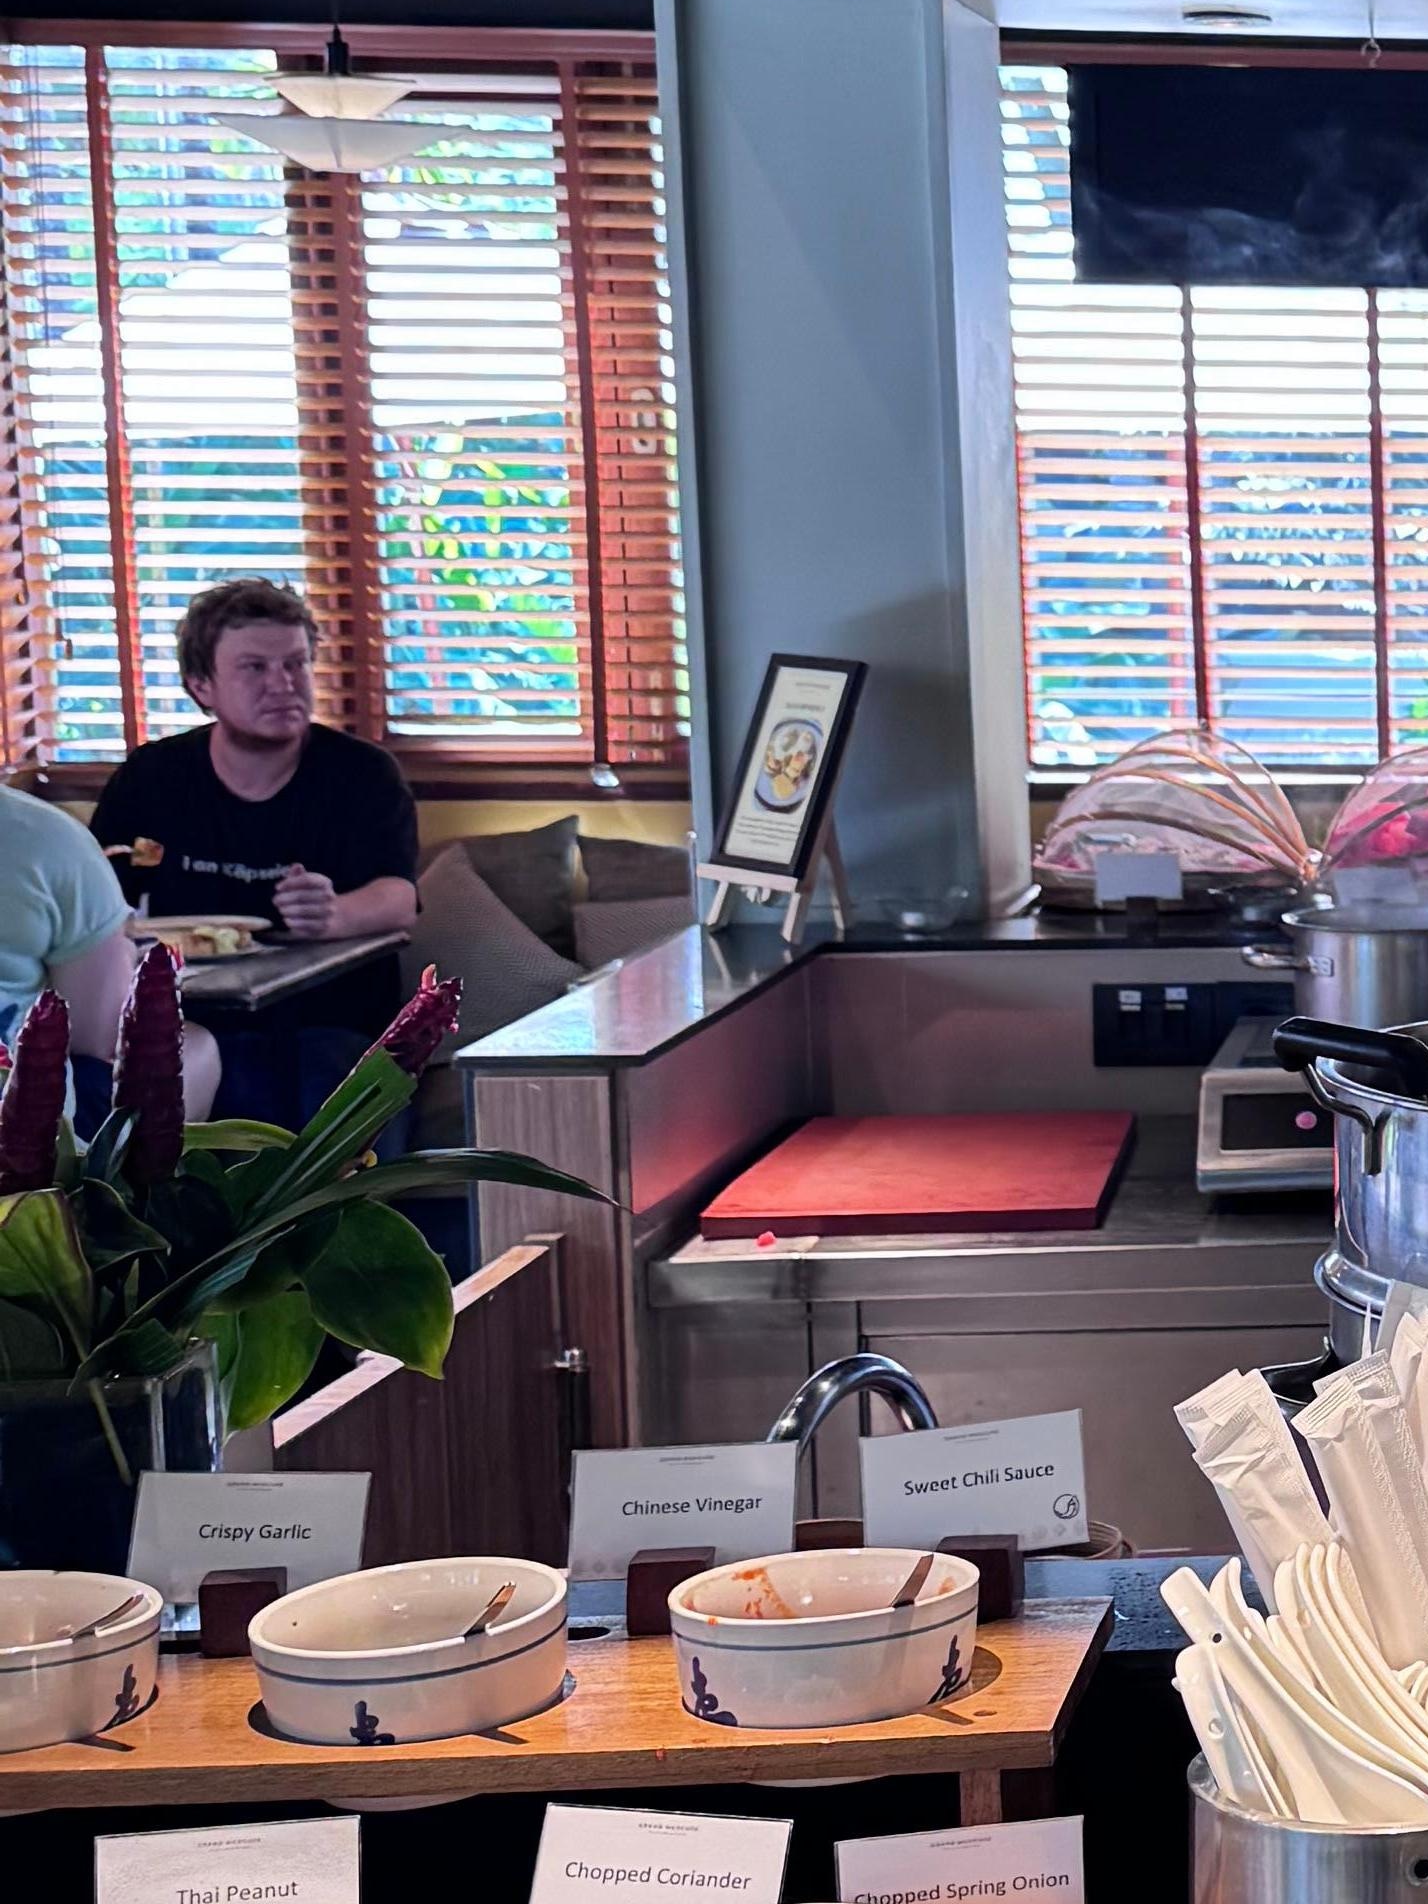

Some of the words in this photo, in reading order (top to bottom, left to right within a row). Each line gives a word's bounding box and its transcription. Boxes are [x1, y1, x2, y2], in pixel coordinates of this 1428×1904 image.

[904, 1475, 958, 1495] Sweet
[962, 1468, 1000, 1487] Chili
[1003, 1464, 1054, 1482] Sauce
[621, 1500, 690, 1516] Chinese
[696, 1497, 763, 1514] Vinegar
[199, 1524, 254, 1542] Crispy
[259, 1524, 312, 1540] Garlic
[565, 1861, 652, 1885] Chopped
[657, 1868, 752, 1890] Coriander
[946, 1879, 1006, 1900] Spring
[1012, 1873, 1070, 1891] Onion
[226, 1881, 299, 1902] Peanut
